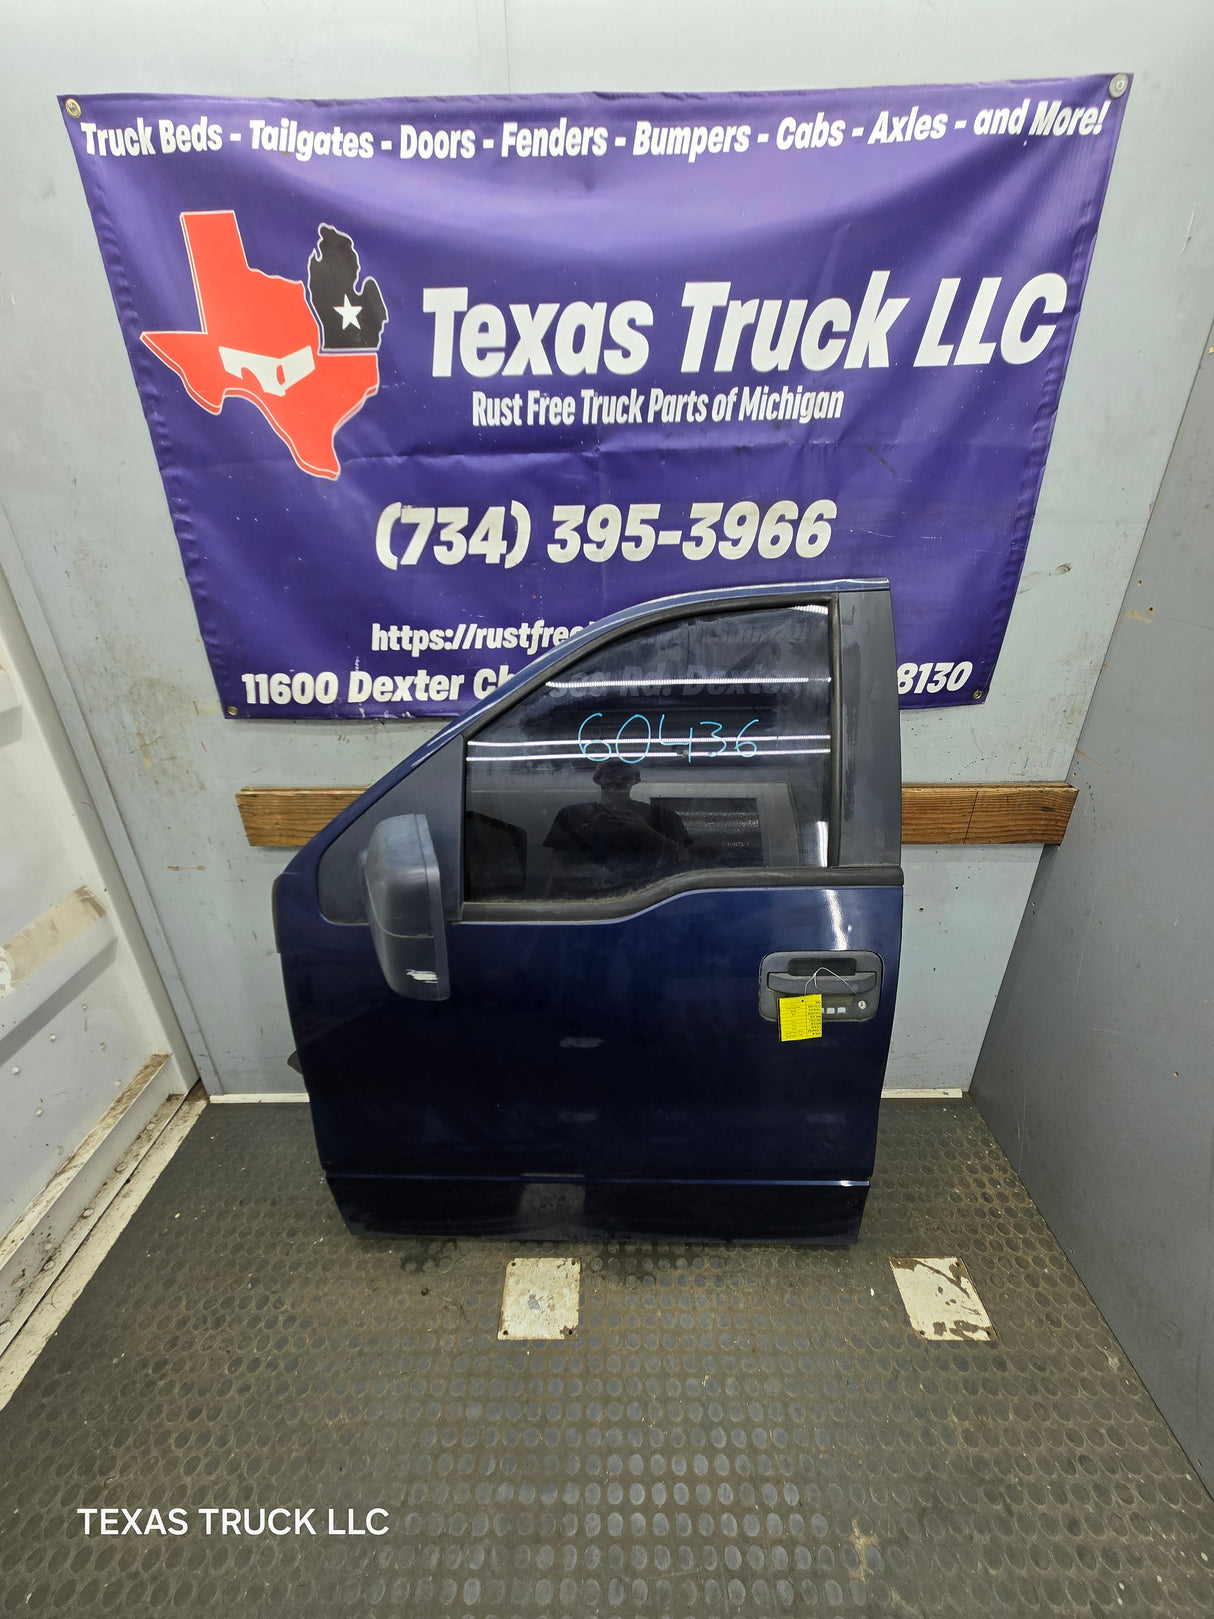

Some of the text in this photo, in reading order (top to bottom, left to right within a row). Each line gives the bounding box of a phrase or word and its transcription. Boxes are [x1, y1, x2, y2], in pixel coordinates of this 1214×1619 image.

[80, 117, 156, 156] Truck
[160, 116, 223, 153] Beds
[249, 117, 374, 163] Tailgates
[400, 125, 476, 159] Doors
[501, 117, 608, 157] Fenders
[633, 121, 751, 163] Bumpers
[776, 112, 846, 151] Cabs
[867, 105, 948, 145] Axles
[973, 98, 1031, 135] and
[1029, 100, 1111, 136] More!
[423, 271, 1068, 377] Texas Truck LLC
[472, 385, 844, 427] Rust Free Truck Parts of Michigan
[376, 500, 837, 569] (734) 395-3966
[372, 620, 597, 657] https://rustfre
[242, 672, 338, 704] 11600
[348, 669, 465, 702] Dexter
[578, 713, 759, 763] 60436
